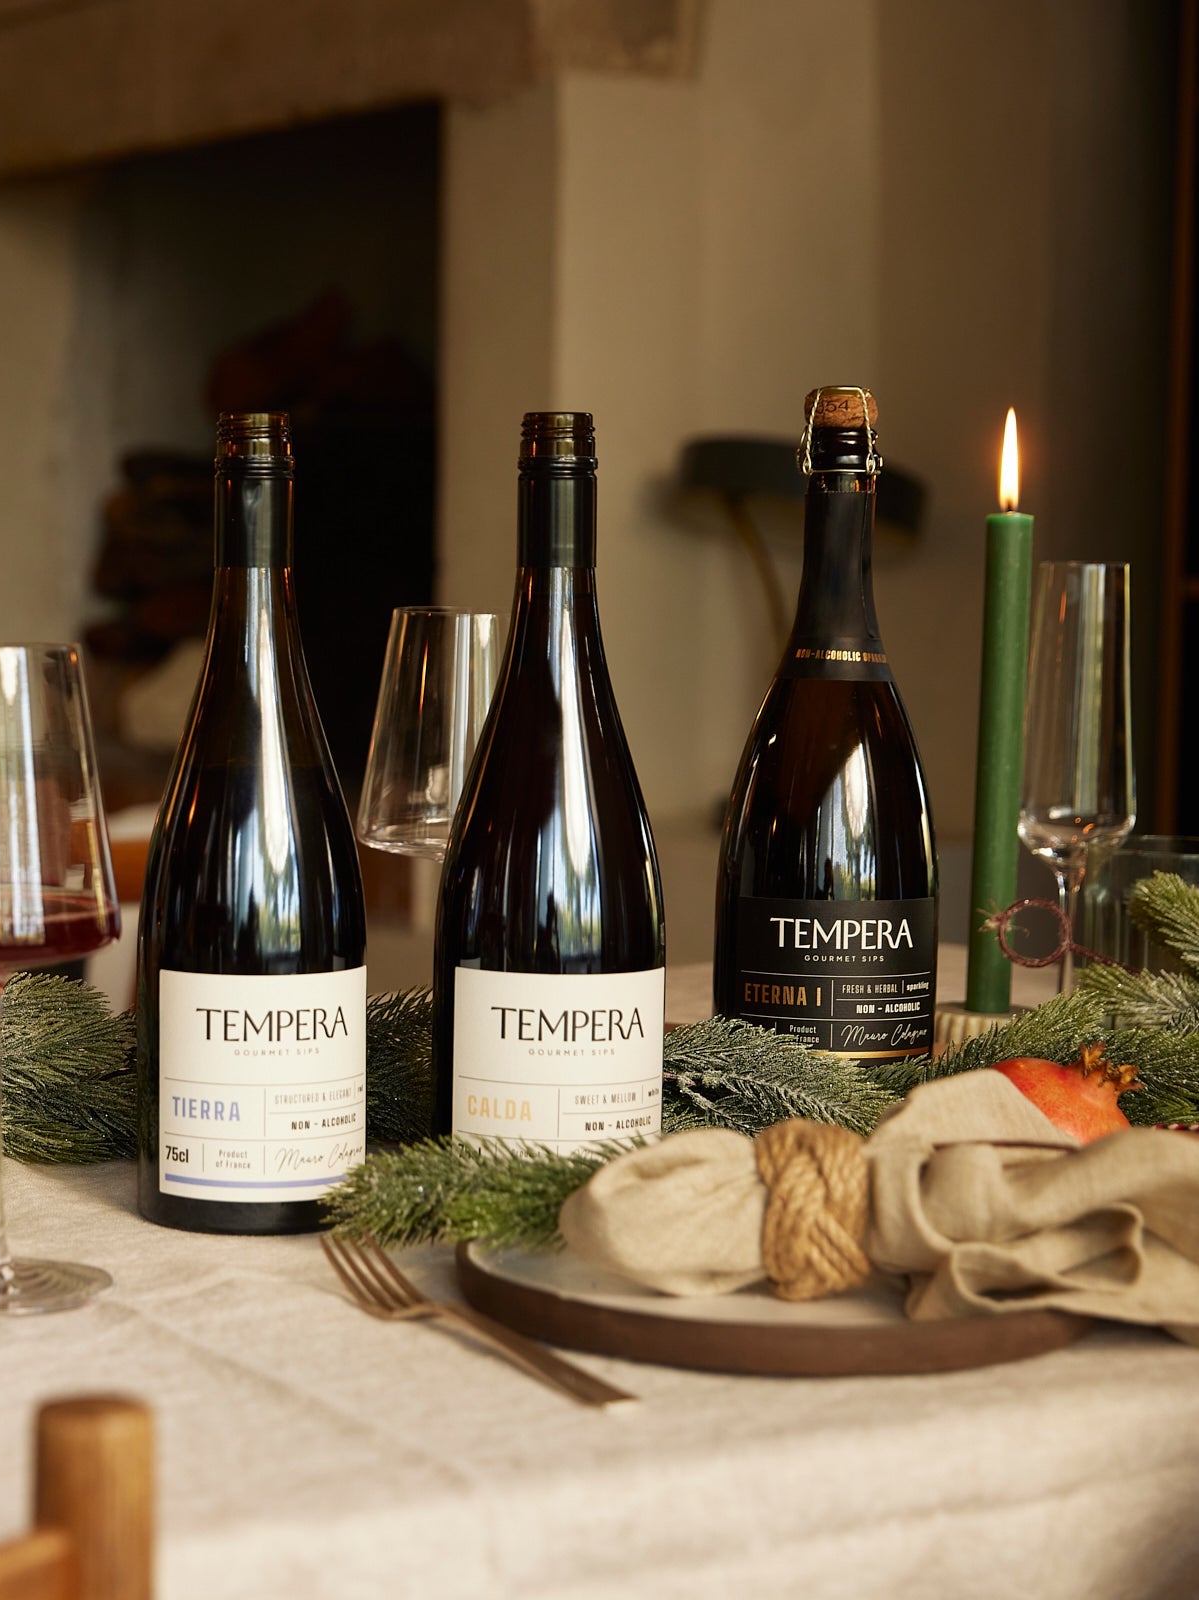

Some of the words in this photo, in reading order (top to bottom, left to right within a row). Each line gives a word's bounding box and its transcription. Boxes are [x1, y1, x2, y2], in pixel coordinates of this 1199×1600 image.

[769, 917, 914, 950] TEMPERA
[804, 954, 856, 963] GOURMET
[862, 954, 885, 963] SIPS
[842, 984, 864, 994] FRESH
[867, 984, 872, 994] &
[874, 983, 898, 994] HERBAL
[906, 981, 930, 992] sparkling
[744, 982, 808, 1007] ETERNA
[815, 986, 822, 1007] I
[856, 1004, 875, 1014] NON
[884, 1001, 921, 1014] ALCOHOLIC
[196, 1006, 348, 1042] TEMPERA
[491, 1006, 644, 1042] TEMPERA
[789, 1024, 817, 1034] Product
[234, 1048, 290, 1057] GOURMET
[296, 1047, 320, 1056] SIPS
[528, 1048, 585, 1057] GOURMET
[592, 1048, 615, 1056] SIPS
[274, 1092, 320, 1105] STRUCTURED
[329, 1087, 352, 1102] ELEGANT
[574, 1095, 599, 1105] SWEET
[611, 1092, 637, 1104] MELLOW
[172, 1096, 241, 1122] TIERRA
[467, 1095, 532, 1121] CALDA
[291, 1120, 311, 1130] NON
[321, 1113, 356, 1128] ALCOHOLIC
[585, 1121, 605, 1132] NON
[615, 1115, 651, 1130] ALCOHOLIC
[165, 1145, 189, 1163] 75cl
[218, 1149, 248, 1159] Product
[226, 1160, 251, 1169] France
